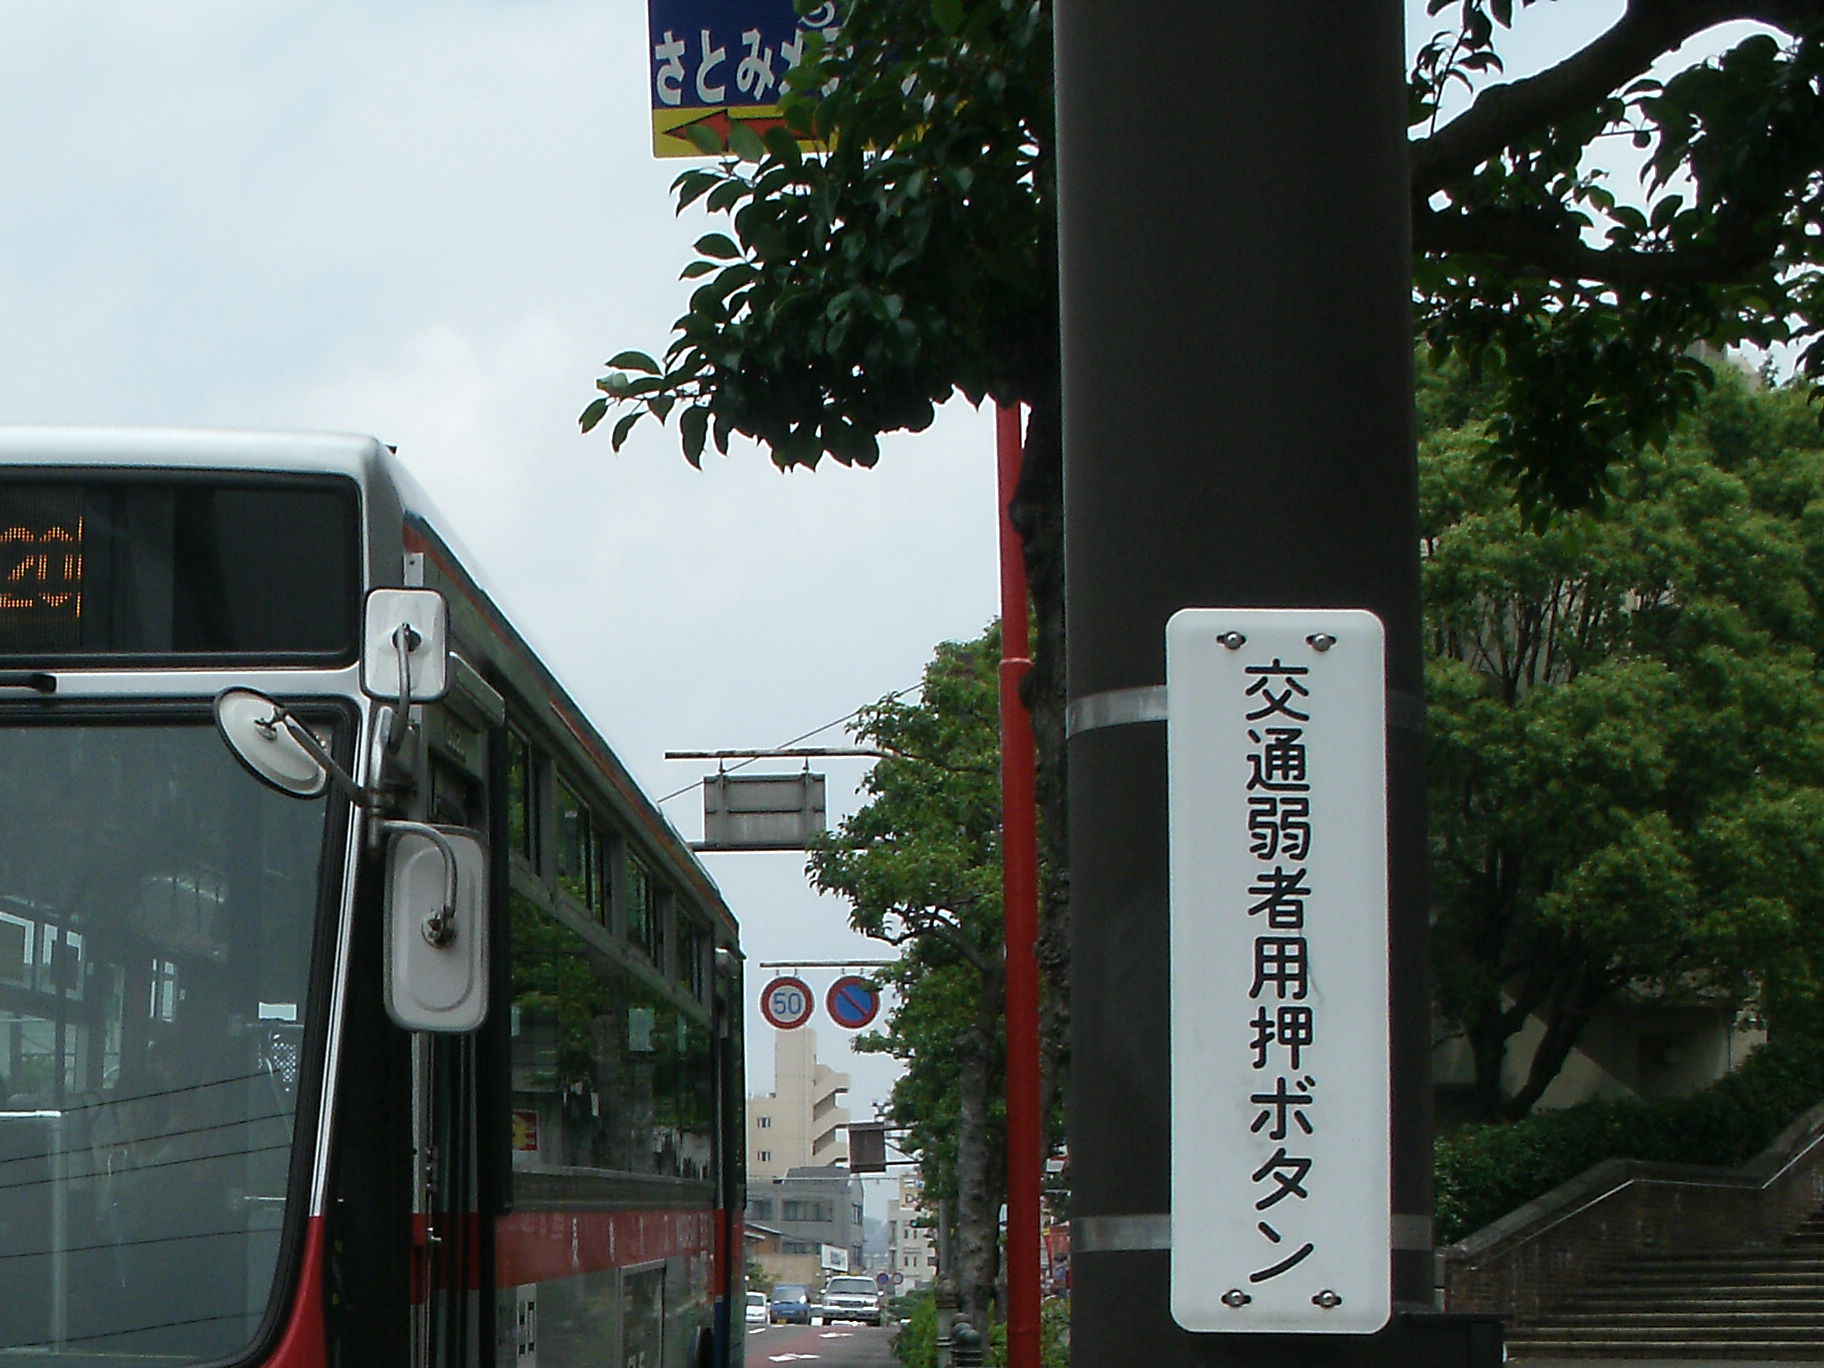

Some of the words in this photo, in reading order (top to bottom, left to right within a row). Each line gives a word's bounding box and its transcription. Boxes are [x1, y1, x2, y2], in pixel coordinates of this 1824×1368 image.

[773, 992, 801, 1015] 50
[1243, 658, 1317, 1284] 交通弱者用押ボタン
